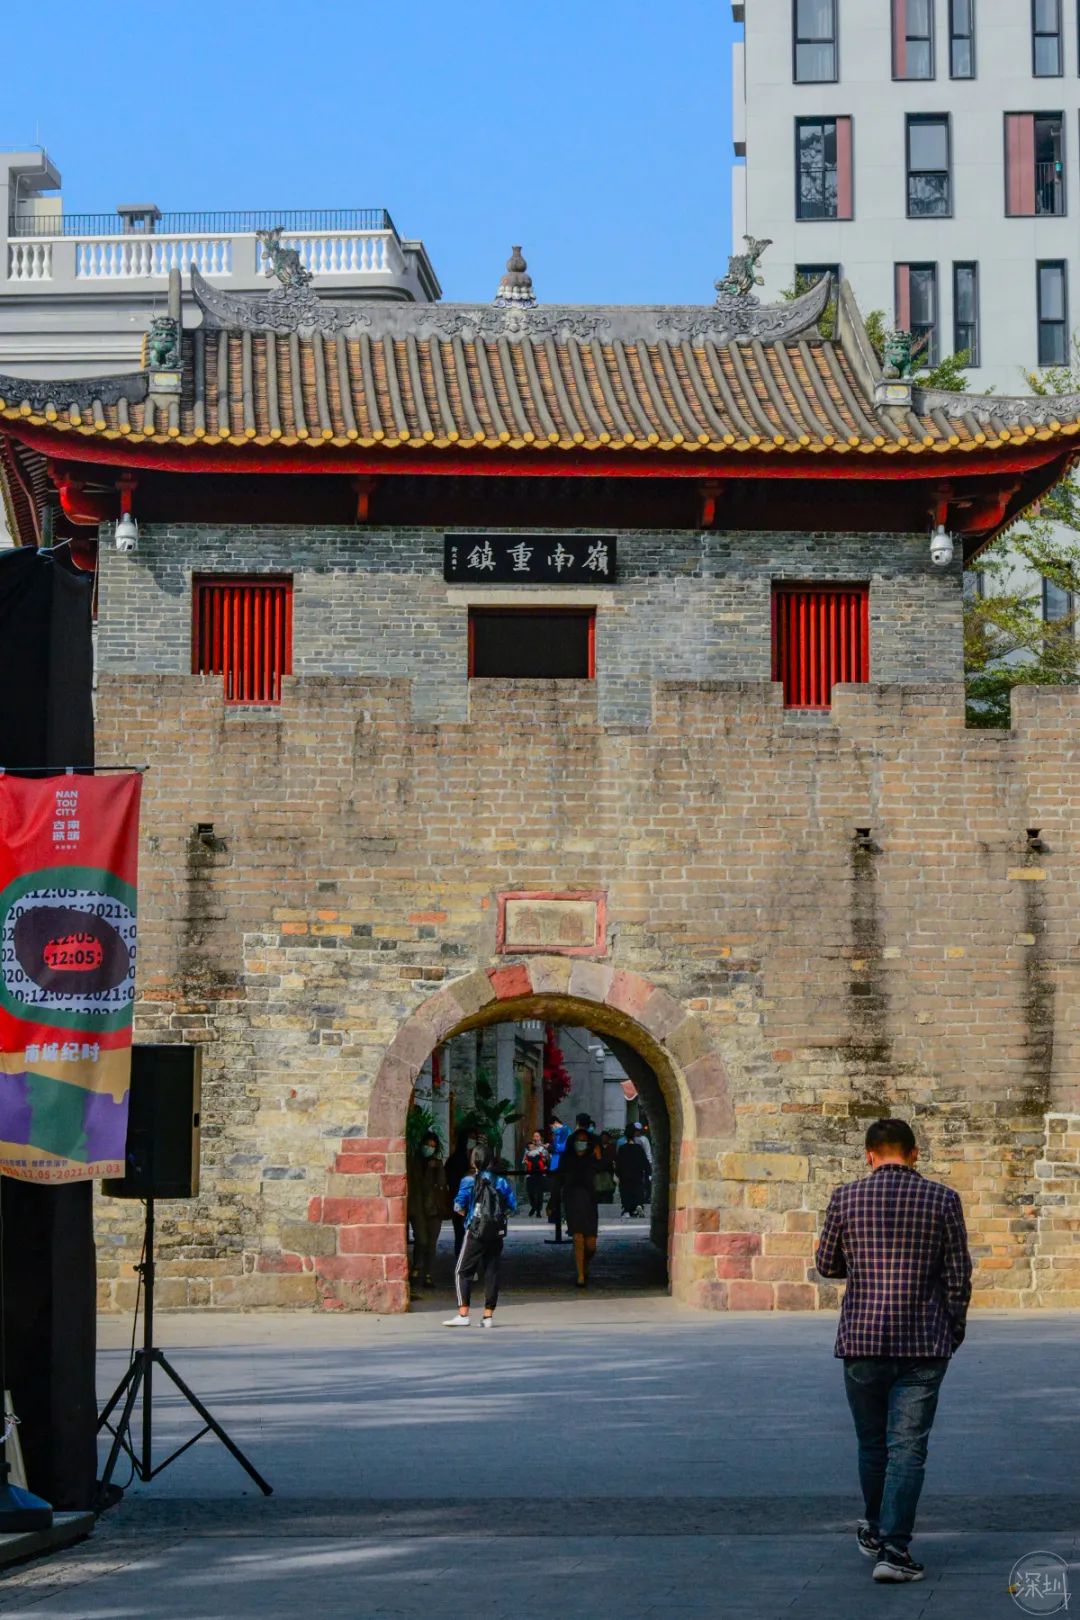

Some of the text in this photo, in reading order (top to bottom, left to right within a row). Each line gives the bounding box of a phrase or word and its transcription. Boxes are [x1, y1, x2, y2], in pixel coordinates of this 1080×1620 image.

[466, 540, 609, 576] 嶺南重鎮
[56, 808, 76, 816] CITY
